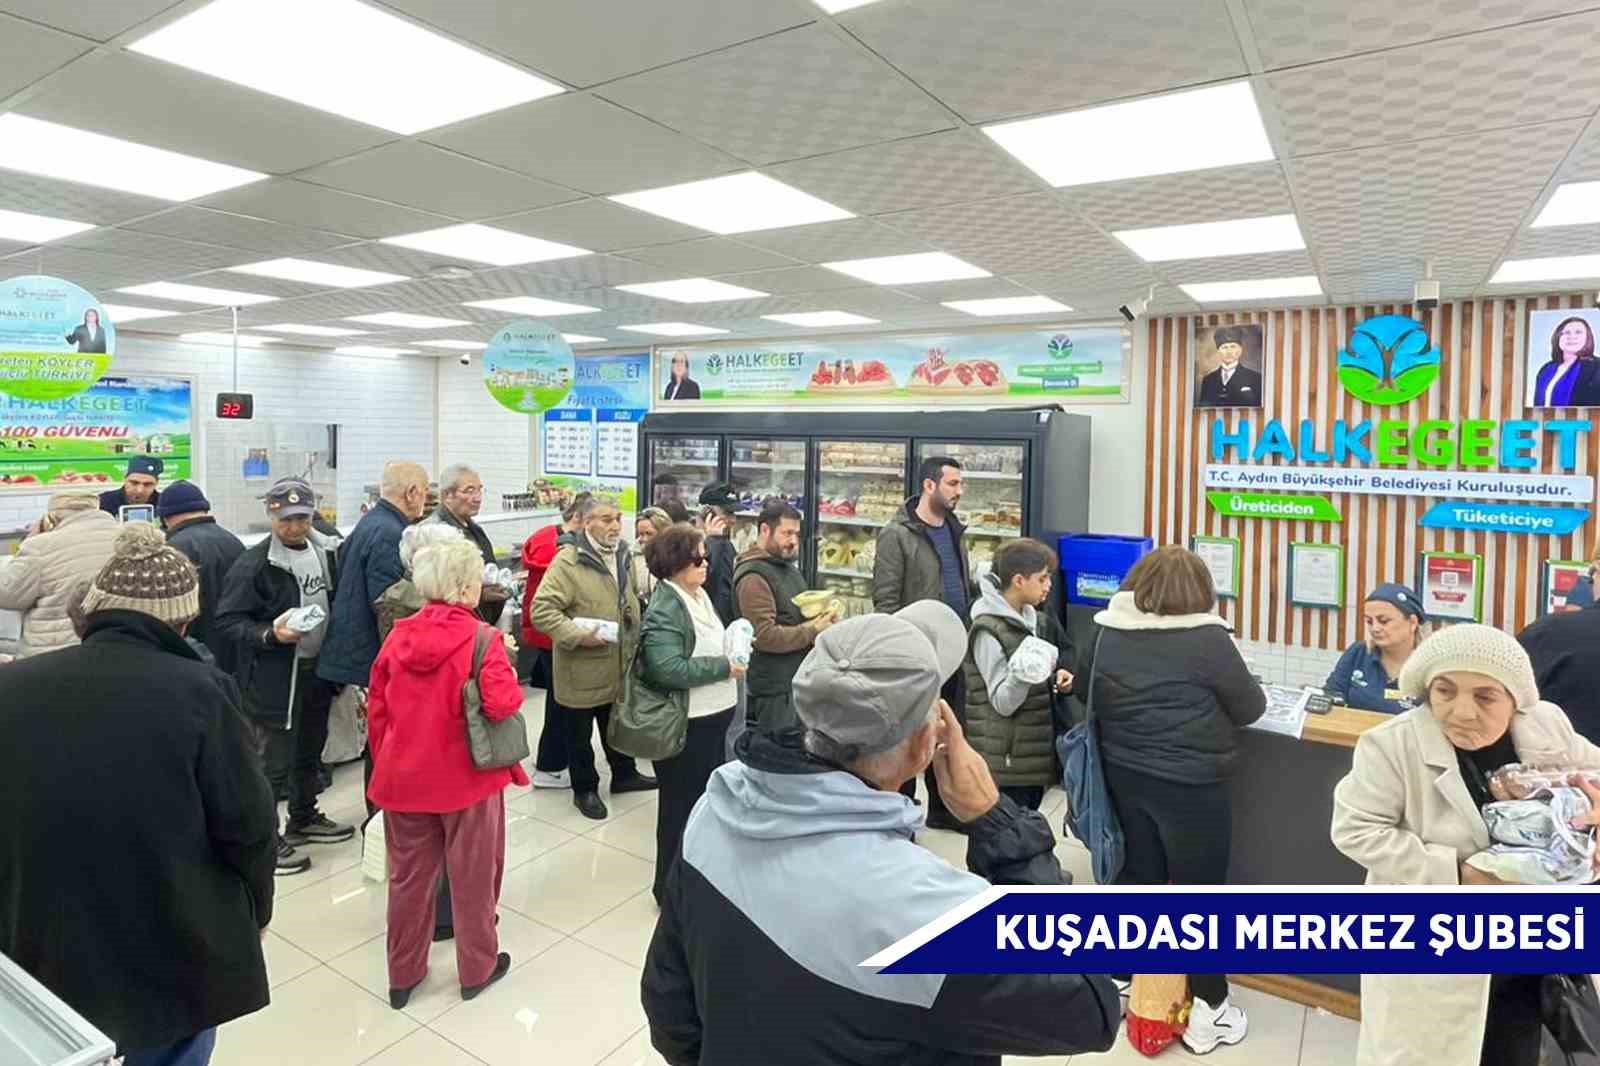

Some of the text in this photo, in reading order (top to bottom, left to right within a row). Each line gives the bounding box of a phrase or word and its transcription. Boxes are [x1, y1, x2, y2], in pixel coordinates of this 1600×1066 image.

[726, 351, 805, 368] HALKEGEET
[9, 396, 147, 411] HALKEGEET
[222, 402, 241, 416] 32
[0, 426, 38, 438] 100
[1210, 418, 1592, 470] HALKEGEET
[1208, 470, 1572, 496] T.C. Aydın Büyükşehir Belediyesi Kuruluşudur.
[1230, 496, 1314, 515] Üreticiden
[1452, 508, 1554, 529] Tüketiciye
